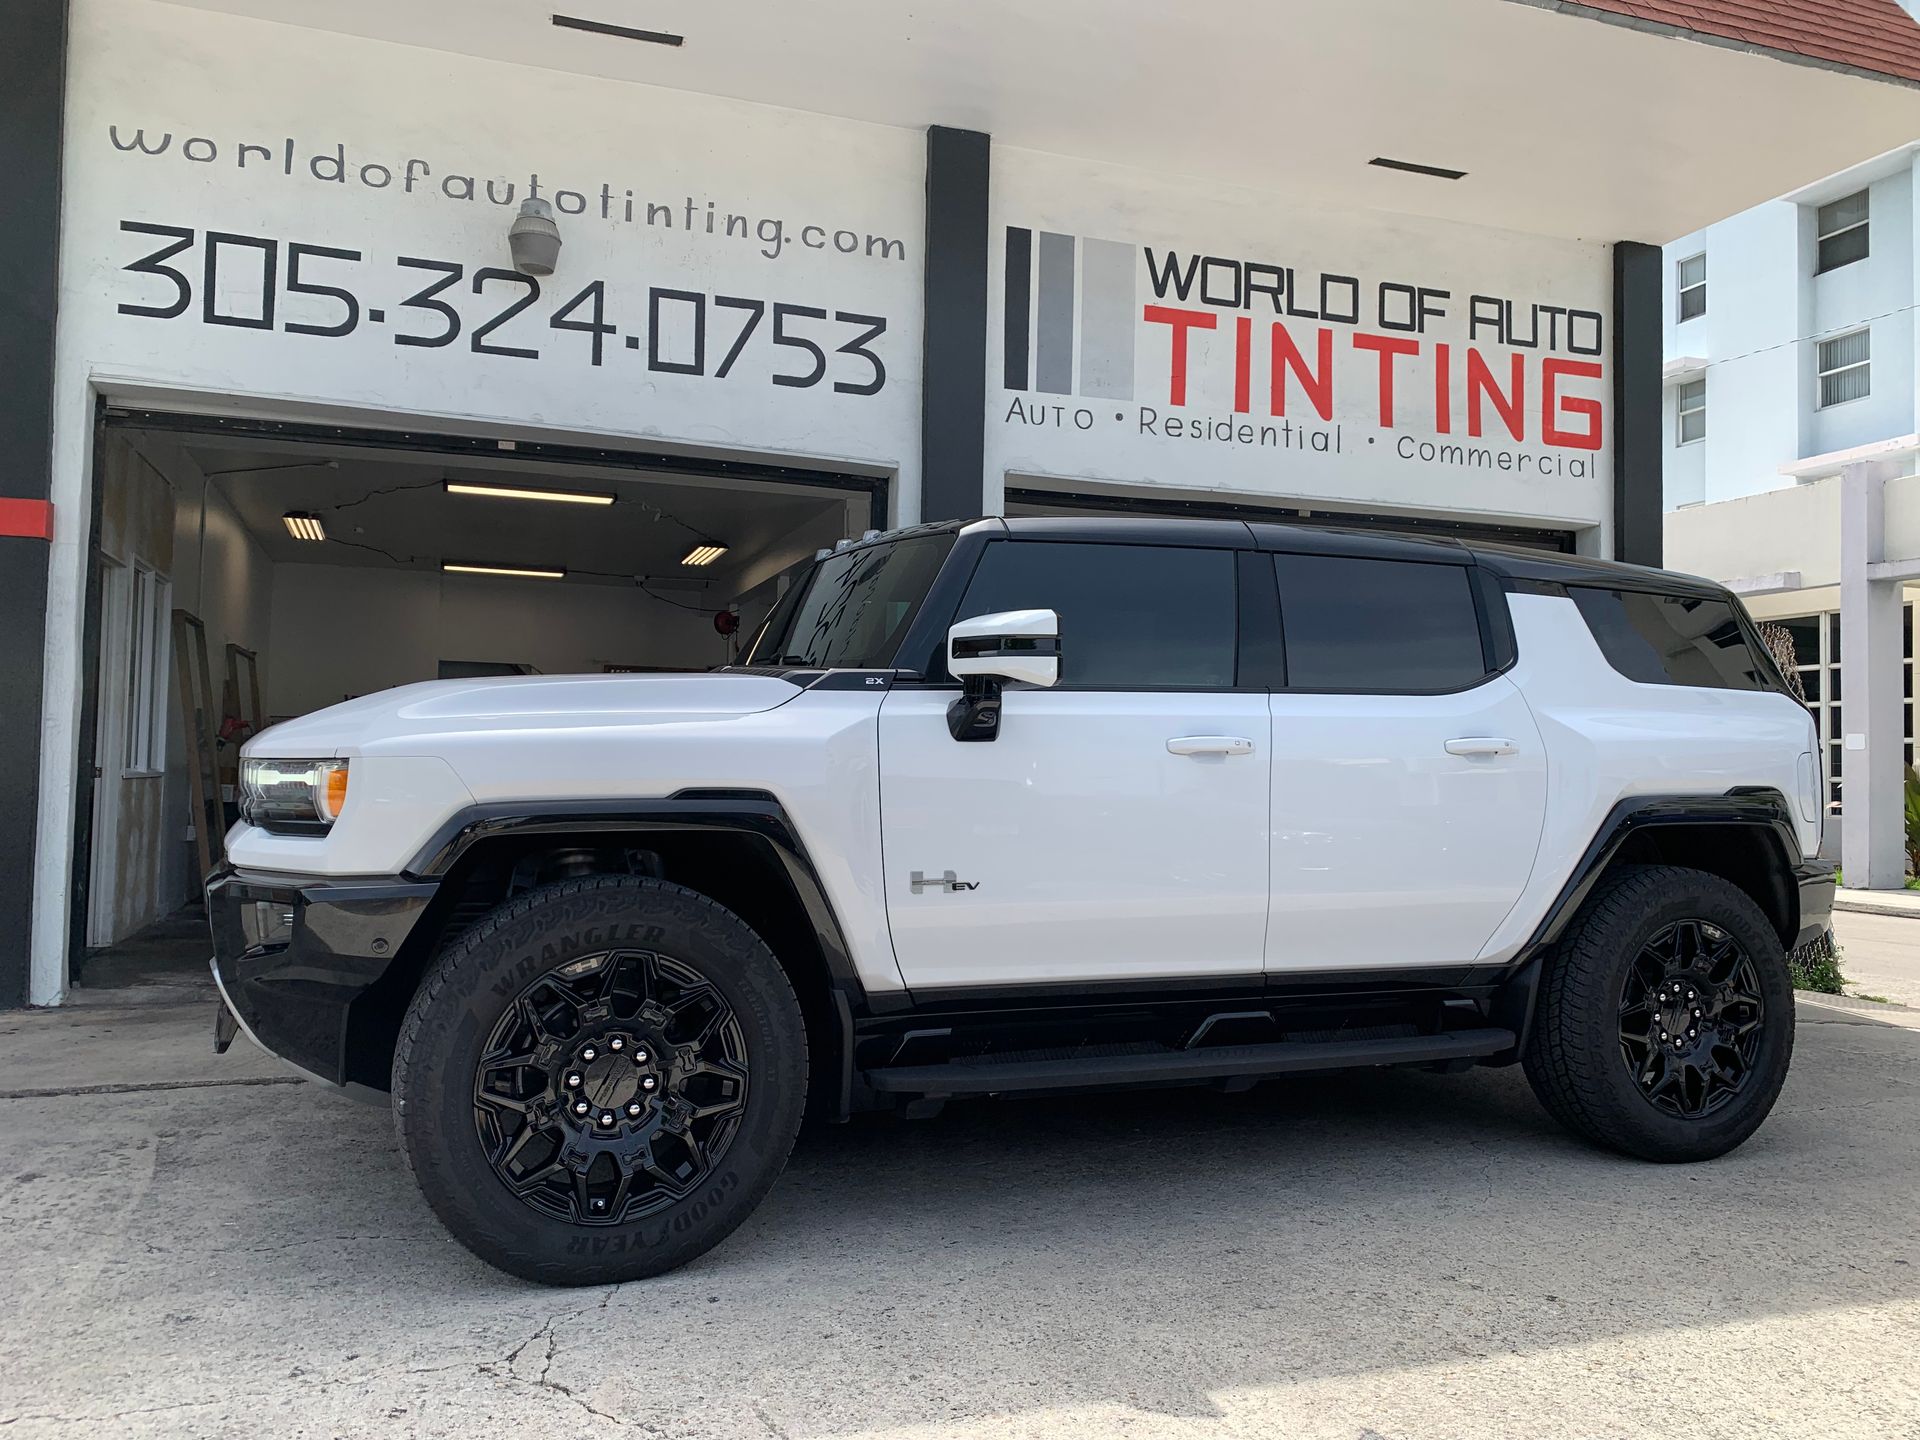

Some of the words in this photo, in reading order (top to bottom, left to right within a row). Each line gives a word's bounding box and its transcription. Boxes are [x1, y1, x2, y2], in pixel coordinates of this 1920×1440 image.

[109, 125, 905, 260] worldofautotinting.com
[1143, 246, 1360, 325] WORLD
[1378, 281, 1451, 334] OF
[1469, 294, 1603, 356] AUTO
[1143, 304, 1603, 451] TINTING
[1139, 406, 1342, 454] Residential
[1397, 436, 1596, 480] Commercial
[865, 677, 885, 685] 2X
[492, 923, 667, 998] WRANGLER
